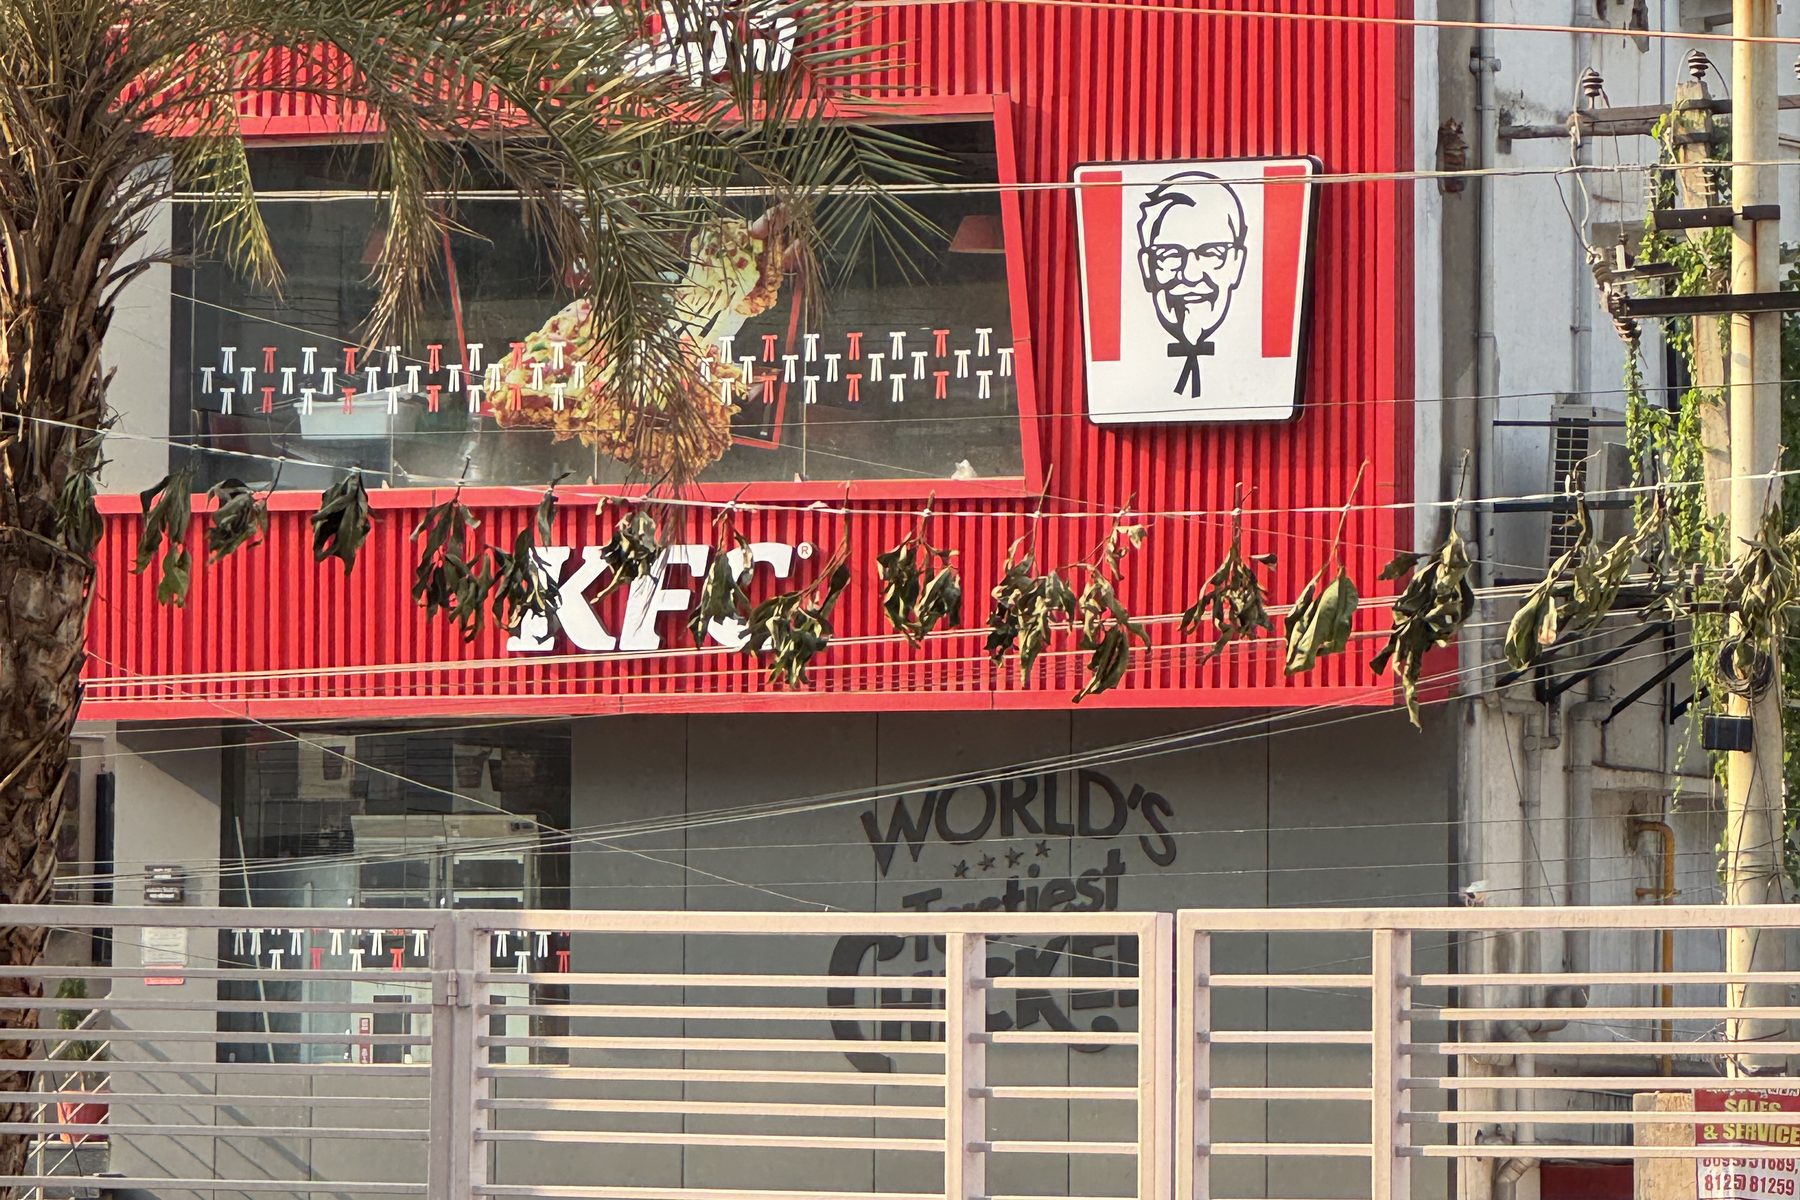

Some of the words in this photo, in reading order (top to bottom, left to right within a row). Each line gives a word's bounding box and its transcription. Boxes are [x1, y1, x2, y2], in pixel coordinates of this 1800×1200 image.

[902, 848, 1126, 962] Ttiest
[1703, 1124, 1719, 1140] &
[1722, 1122, 1800, 1146] SERVICE
